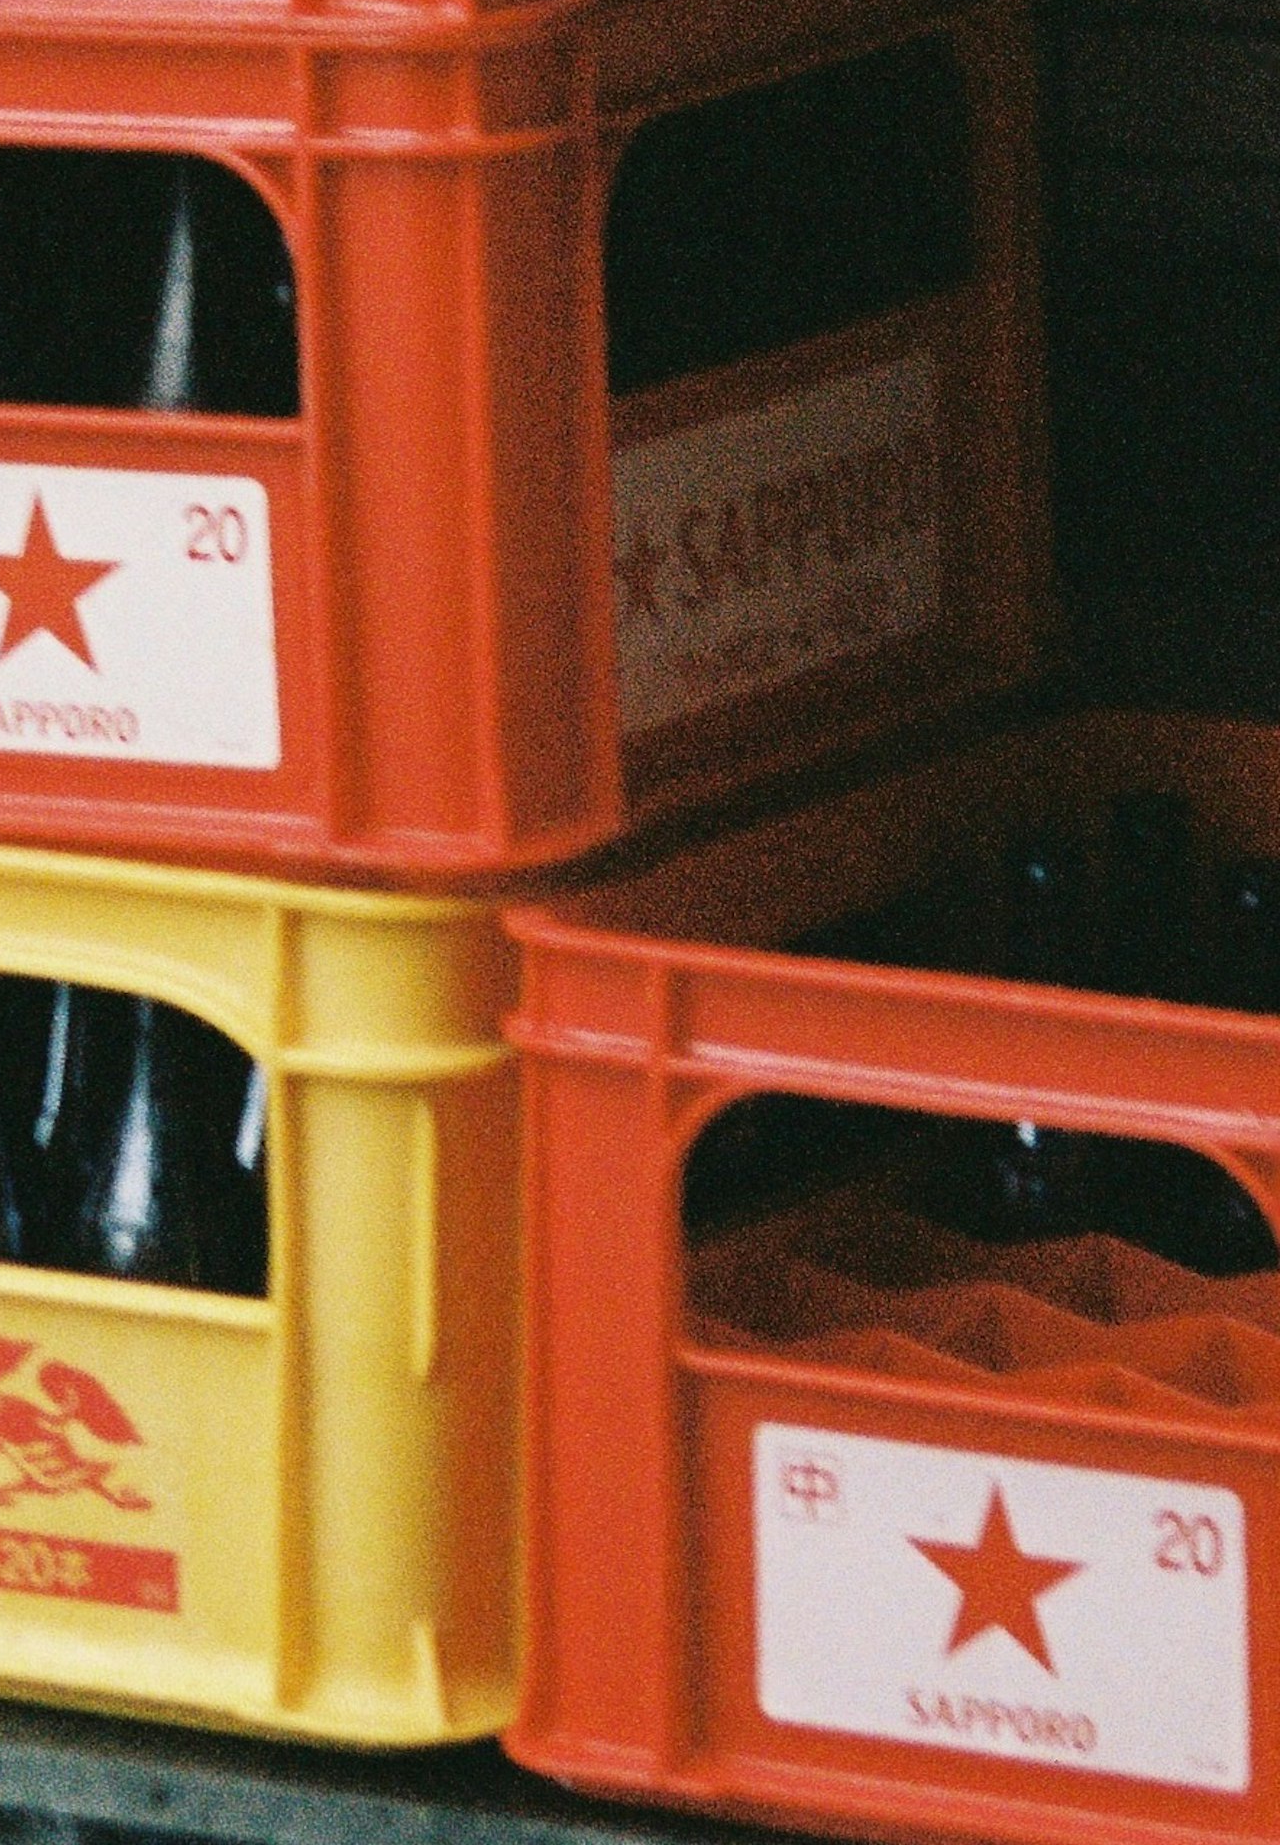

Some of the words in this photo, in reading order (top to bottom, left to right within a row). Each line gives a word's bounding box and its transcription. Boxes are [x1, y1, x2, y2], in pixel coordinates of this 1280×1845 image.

[184, 505, 248, 565] 20
[785, 1454, 841, 1521] 中
[1155, 1512, 1224, 1577] 20
[907, 1688, 1096, 1752] SAPPORO
